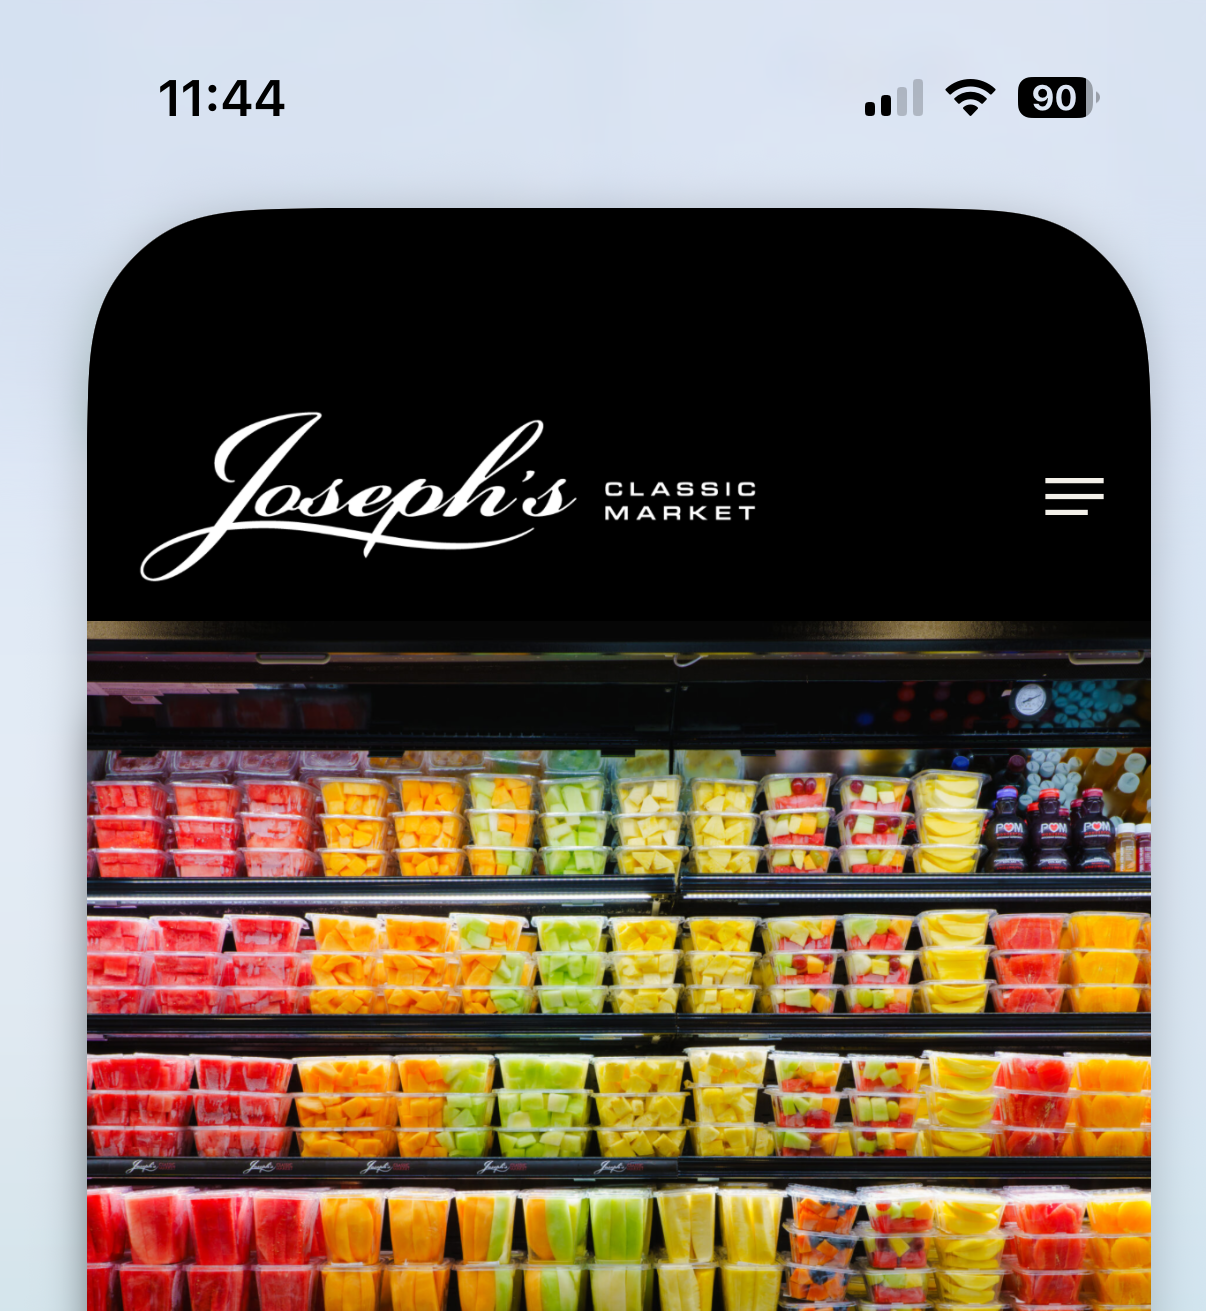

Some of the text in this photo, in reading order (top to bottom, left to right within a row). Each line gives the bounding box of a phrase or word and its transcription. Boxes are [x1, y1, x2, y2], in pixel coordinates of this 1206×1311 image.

[160, 80, 284, 117] 11:44
[1032, 84, 1077, 111] 90
[140, 411, 577, 582] Joseph's
[604, 481, 756, 497] CLASSIC
[604, 505, 756, 521] MARKET
